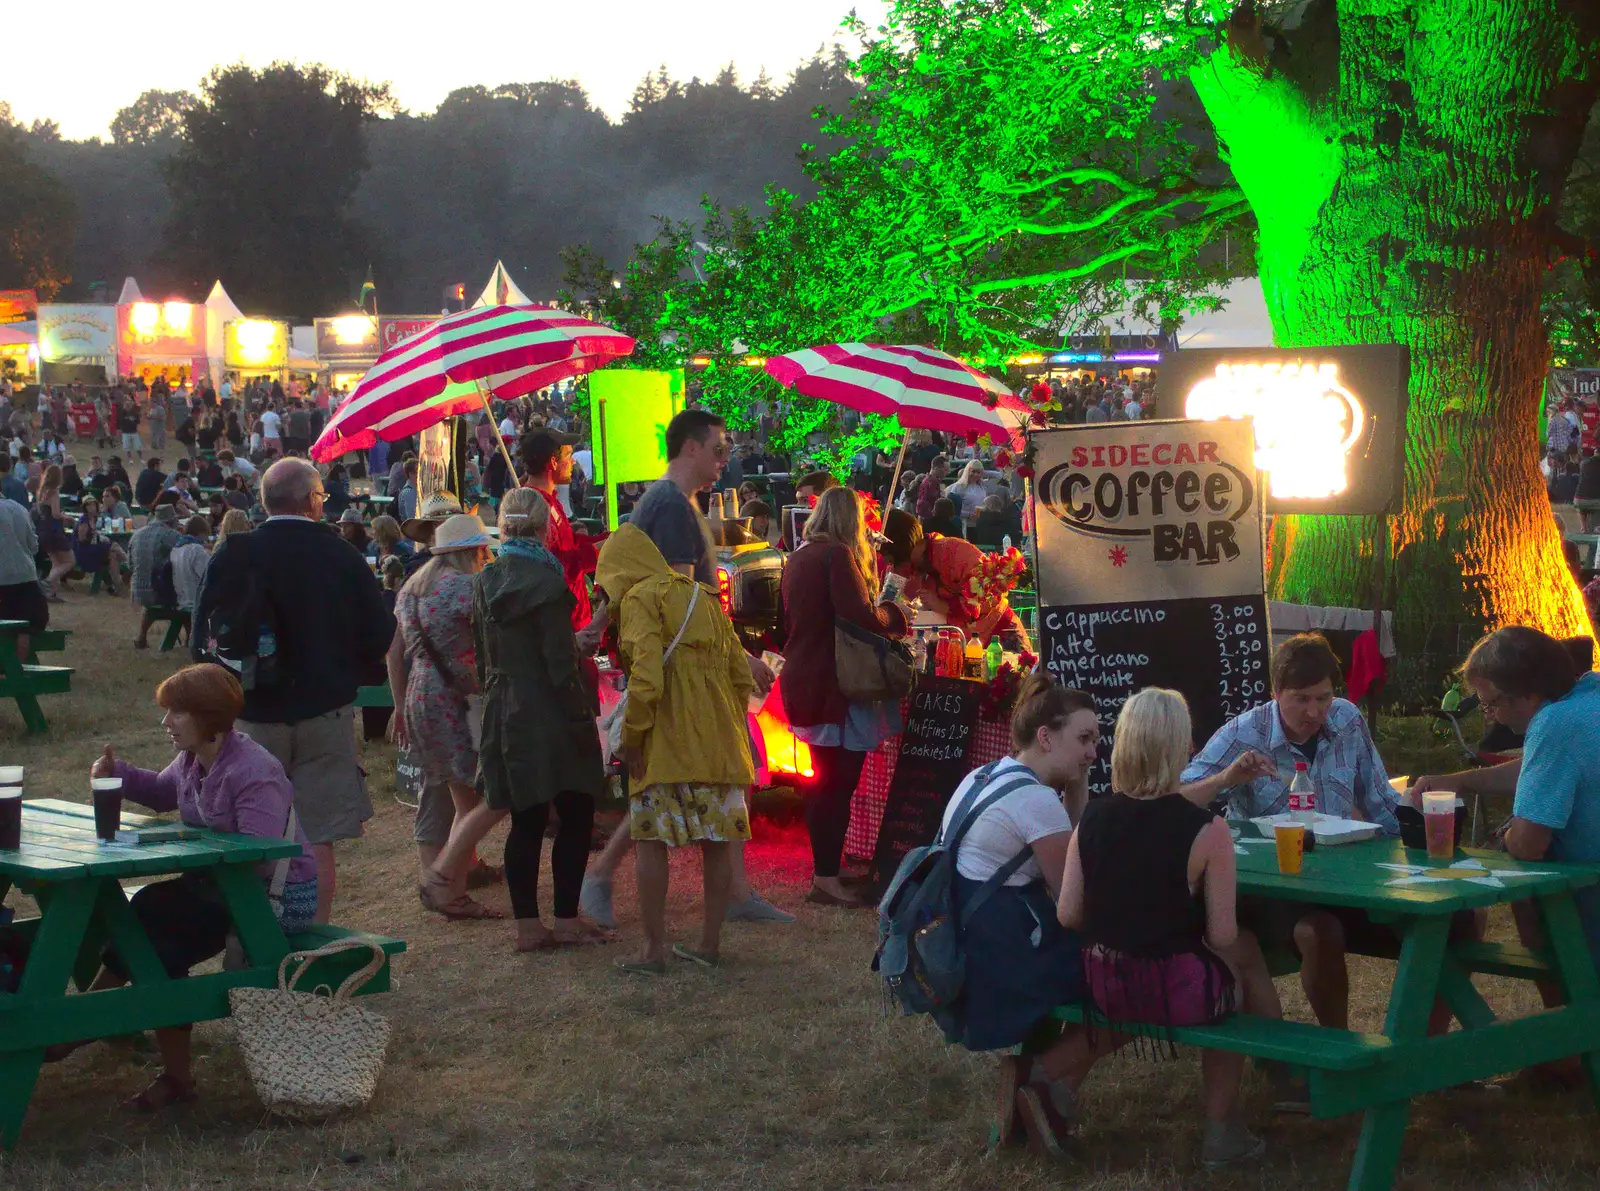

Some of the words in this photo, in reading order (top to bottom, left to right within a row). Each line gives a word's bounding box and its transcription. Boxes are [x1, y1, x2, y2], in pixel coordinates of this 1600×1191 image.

[1072, 442, 1221, 467] SIDECAR
[1153, 520, 1241, 566] BAR
[1045, 608, 1166, 637] Cappuccino
[1210, 604, 1254, 621] 3.00
[1215, 622, 1257, 640] 3.00
[1047, 652, 1149, 673] americano
[1219, 640, 1261, 657] 2.50
[1089, 670, 1134, 687] white
[1220, 659, 1262, 676] 3.50
[1219, 679, 1265, 697] 2.50
[915, 692, 962, 714] CAKES
[907, 718, 947, 740] Muffins
[948, 724, 969, 740] 2.50
